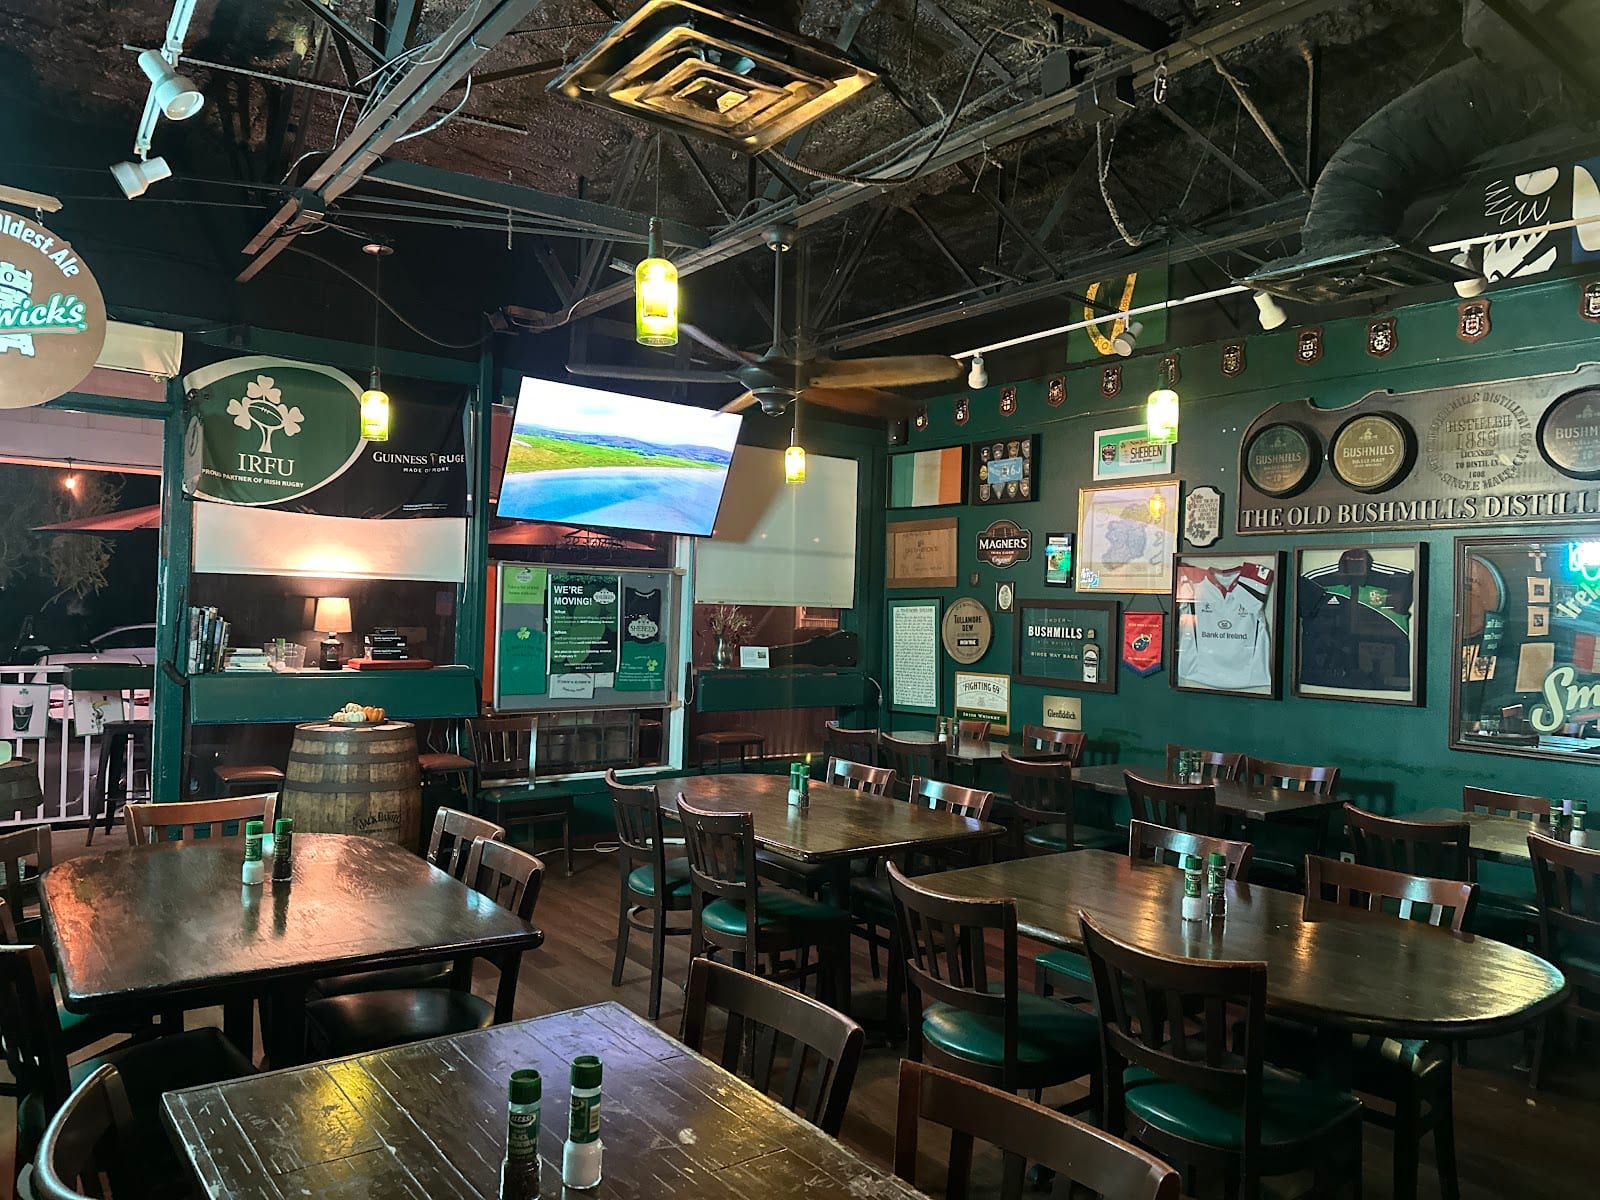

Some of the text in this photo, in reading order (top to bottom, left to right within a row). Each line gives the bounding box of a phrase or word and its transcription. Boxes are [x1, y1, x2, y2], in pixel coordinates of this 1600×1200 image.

[0, 213, 80, 278] ldest Ale
[372, 451, 428, 465] GUINNESS
[1130, 444, 1163, 460] SHEBEEN
[1343, 445, 1395, 458] BUSHMILLS
[237, 453, 295, 477] IRFU
[1255, 452, 1302, 465] BUSHMILLS
[201, 468, 222, 478] PROUD
[222, 473, 253, 483] PARTNER
[1241, 507, 1284, 528] THE
[1286, 504, 1332, 526] OLD
[1337, 496, 1477, 524] BUSHMILLS
[1483, 489, 1600, 518] DISTILL
[979, 537, 1028, 550] MAGNERS
[553, 585, 584, 595] WE'RE
[553, 597, 593, 606] MOVING!
[961, 624, 974, 632] DEW
[1028, 626, 1083, 639] BUSHMILLS
[1201, 631, 1248, 640] Bank of Ireland
[1047, 708, 1077, 720] Glenfiddich
